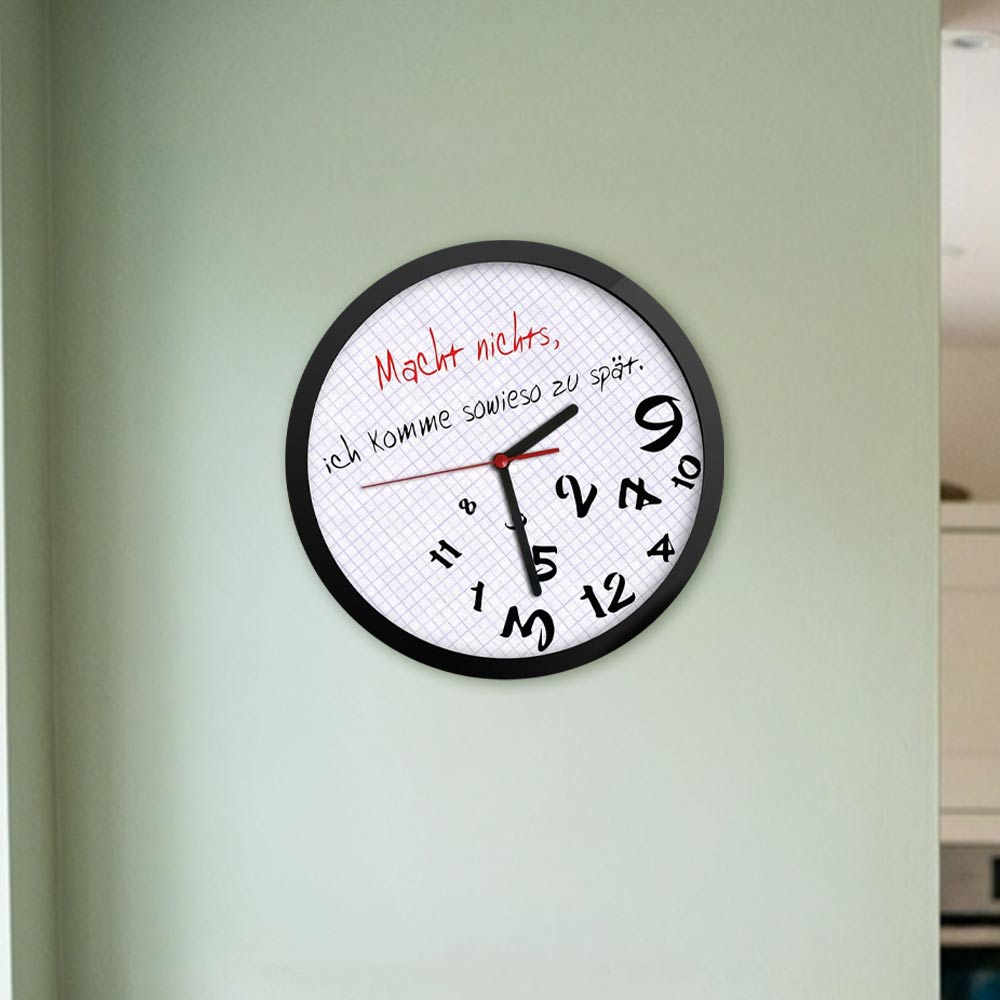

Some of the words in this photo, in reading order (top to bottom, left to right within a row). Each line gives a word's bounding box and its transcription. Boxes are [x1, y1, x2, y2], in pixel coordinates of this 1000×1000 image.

[375, 327, 465, 391] Macht
[477, 310, 560, 361] nichts,
[323, 434, 362, 474] ich
[462, 384, 542, 422] sowieso
[590, 354, 644, 393] spät.
[634, 394, 683, 453] 9
[670, 454, 702, 490] 10
[458, 498, 478, 516] 8
[555, 474, 598, 519] 2
[429, 539, 463, 570] 11
[532, 545, 558, 582] 5
[646, 532, 676, 563] 4
[470, 580, 485, 613] 1
[578, 571, 636, 619] 12
